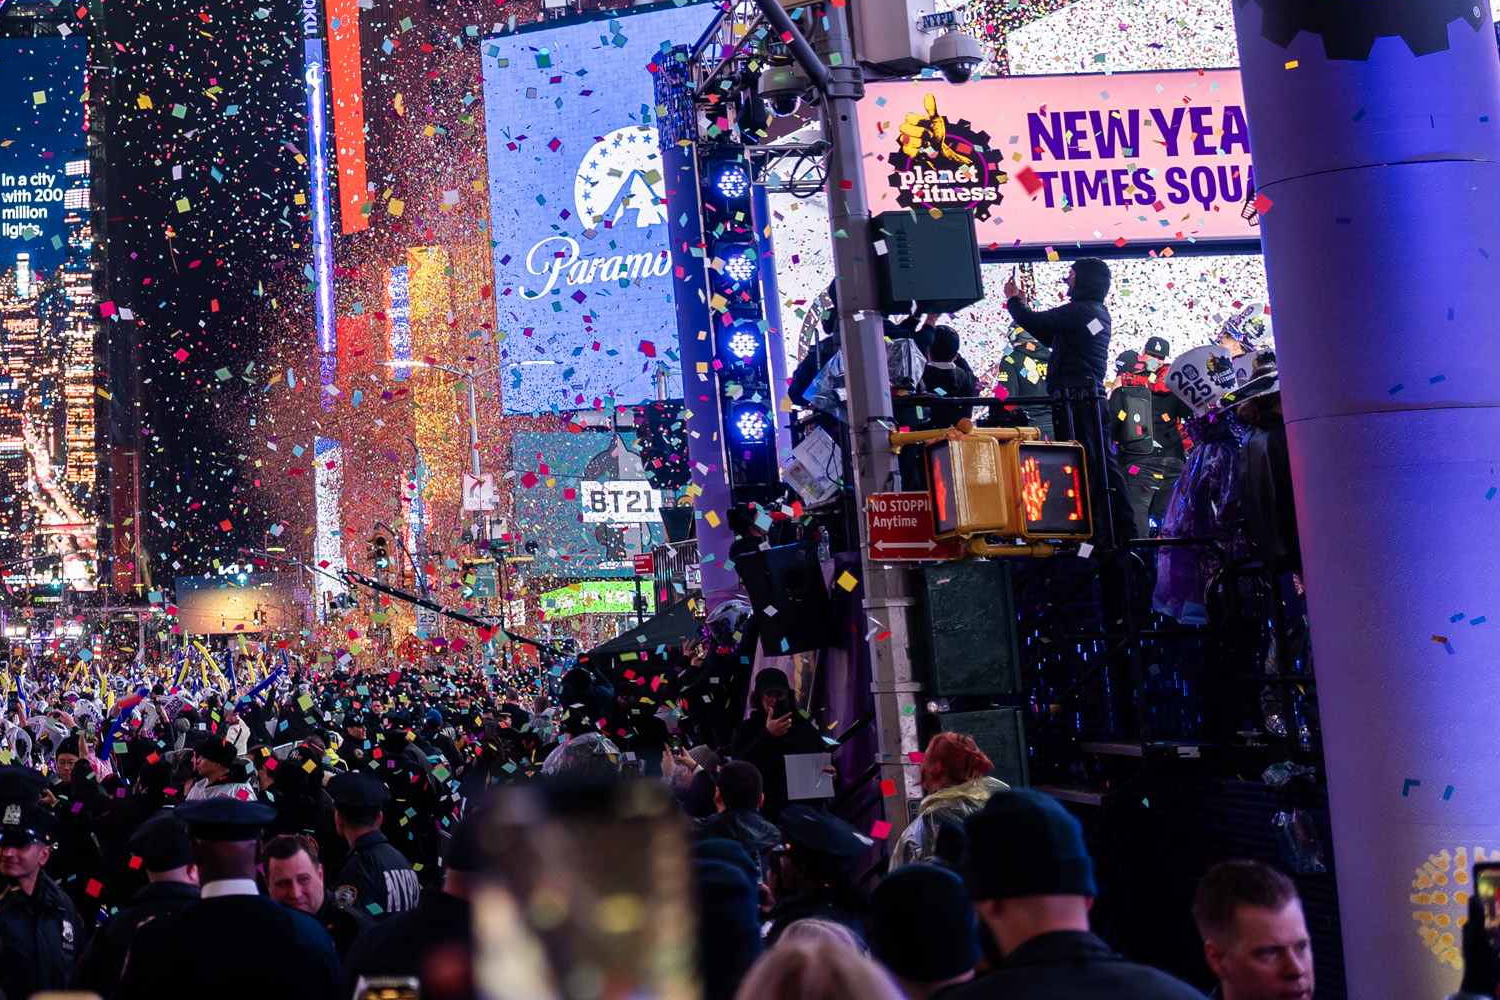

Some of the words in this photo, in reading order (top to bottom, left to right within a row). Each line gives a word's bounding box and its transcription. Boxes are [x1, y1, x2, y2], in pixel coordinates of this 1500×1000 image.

[922, 11, 954, 29] NYPD
[1027, 108, 1140, 161] NEW
[1, 173, 15, 187] In
[17, 176, 28, 187] a
[30, 172, 56, 191] city
[899, 165, 979, 190] planet
[1, 189, 32, 203] with
[34, 188, 64, 203] 200
[911, 182, 998, 203] fitness
[1036, 166, 1156, 209] TIMES
[1164, 163, 1253, 213] SQU
[2, 205, 48, 220] million
[590, 490, 655, 513] BT21
[871, 500, 888, 512] NO
[889, 499, 932, 512] STOPPI
[872, 515, 918, 530] Anytime
[419, 612, 437, 623] 25
